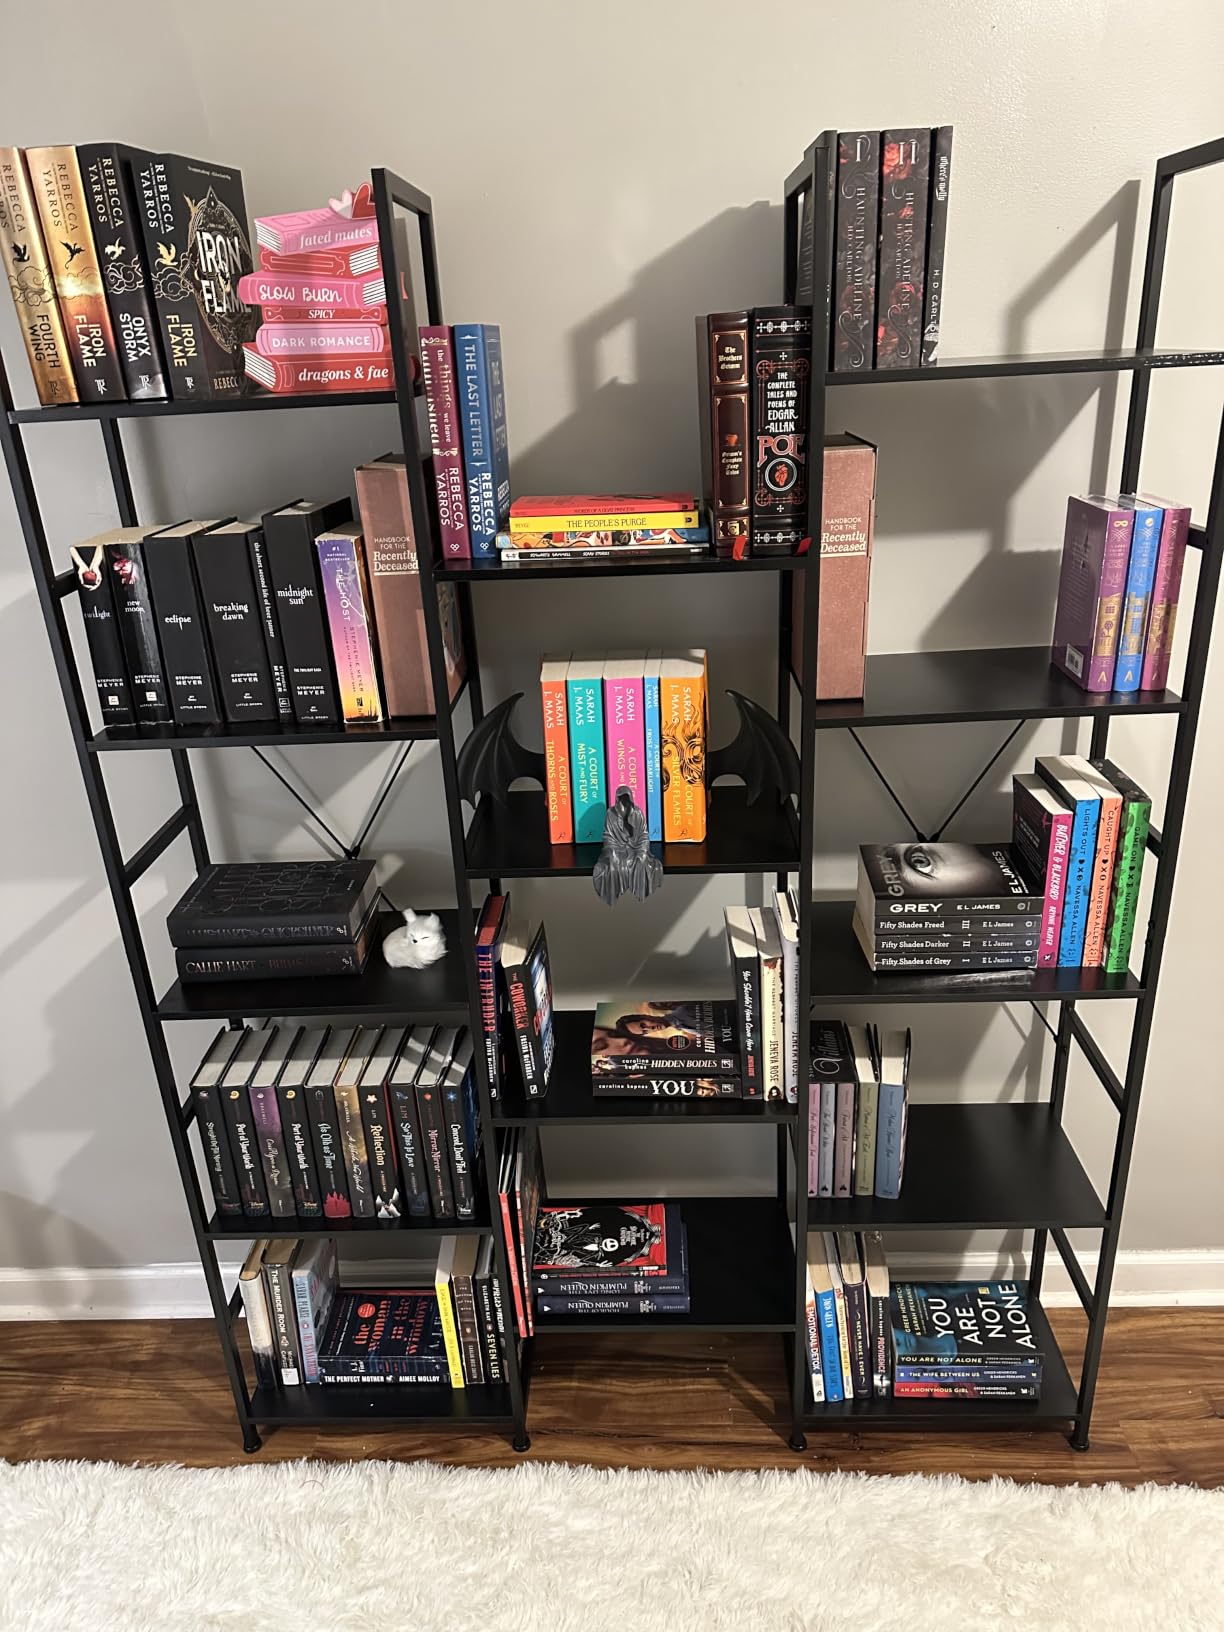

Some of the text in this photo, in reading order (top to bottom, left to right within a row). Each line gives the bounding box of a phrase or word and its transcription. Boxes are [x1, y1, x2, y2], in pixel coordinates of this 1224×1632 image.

[2, 164, 24, 232] REBECCA
[42, 170, 62, 227] YARROS
[57, 163, 77, 231] REBECCA
[88, 165, 108, 223] YARROS
[102, 158, 124, 228] REBECCA
[140, 170, 158, 228] YARROS
[155, 164, 175, 233] REBECCA
[197, 231, 242, 273] IRON
[300, 228, 372, 249] fated mates
[853, 187, 866, 320] HAUNTING ADELINE
[259, 285, 295, 300] SLOW
[308, 310, 335, 319] SPICY
[28, 324, 46, 361] WING
[36, 314, 61, 368] FOURTH
[73, 315, 96, 367] FLAME
[88, 323, 107, 357] IRON
[119, 313, 139, 362] STORM
[132, 317, 151, 356] ONYX
[166, 315, 187, 367] FLAME
[180, 323, 197, 357] IRON
[272, 336, 371, 348] DARK ROMANCE
[299, 366, 388, 383] dragons & fae
[768, 381, 796, 389] COMPLETE
[778, 372, 787, 380] THE
[465, 345, 483, 456] THE LAST LETTER
[768, 400, 795, 409] POEMS OF
[768, 409, 798, 420] EDGAR
[766, 422, 795, 433] ALLAN
[757, 435, 804, 466] POE
[436, 473, 450, 526] YARROS
[449, 468, 465, 530] REBECCA
[469, 478, 482, 532] YARROS
[482, 473, 495, 535] REBECCA
[584, 519, 619, 527] PEOPLE'S
[622, 518, 646, 526] PURGE
[825, 517, 862, 525] HANDBOOK
[821, 543, 866, 553] Deceased
[822, 532, 865, 544] Recently
[214, 603, 248, 613] breaking
[278, 585, 313, 599] midnight
[165, 615, 191, 630] eclipse
[273, 665, 282, 693] MEYER
[545, 701, 554, 729] MAAS
[555, 693, 564, 726] SARAH
[586, 689, 595, 723] SARAH
[626, 688, 635, 721] SARAH
[683, 688, 691, 721] SARAH
[1081, 809, 1090, 840] LIGHTS
[877, 854, 905, 896] GREY
[1091, 810, 1114, 945] CAUGHT UP NAVESSA ALLEN
[890, 904, 943, 912] GREY
[1074, 885, 1082, 917] NAVESSA
[962, 921, 970, 929] III
[1069, 919, 1077, 945] ALLEN
[186, 962, 223, 974] CALLIE
[227, 960, 256, 971] HART
[478, 953, 496, 1032] THE INTRUDER
[510, 982, 529, 1030] COWORKER
[686, 1059, 717, 1067] BODIES
[650, 1080, 694, 1095] YOU
[320, 1133, 333, 1146] Old
[370, 1124, 386, 1166] Reflection
[402, 1132, 413, 1146] This
[323, 1153, 336, 1169] Time
[405, 1153, 416, 1168] Love
[273, 1286, 282, 1316] MURDER
[977, 1298, 1007, 1337] NOT
[998, 1284, 1036, 1349] ALONE
[277, 1315, 286, 1333] ROOM
[354, 1322, 371, 1345] the
[368, 1300, 391, 1351] woman
[928, 1298, 954, 1338] YOU
[955, 1307, 983, 1345] ARE
[487, 1334, 500, 1378] SEVEN LIES
[807, 1307, 820, 1374] EMOTIONAL DETOX
